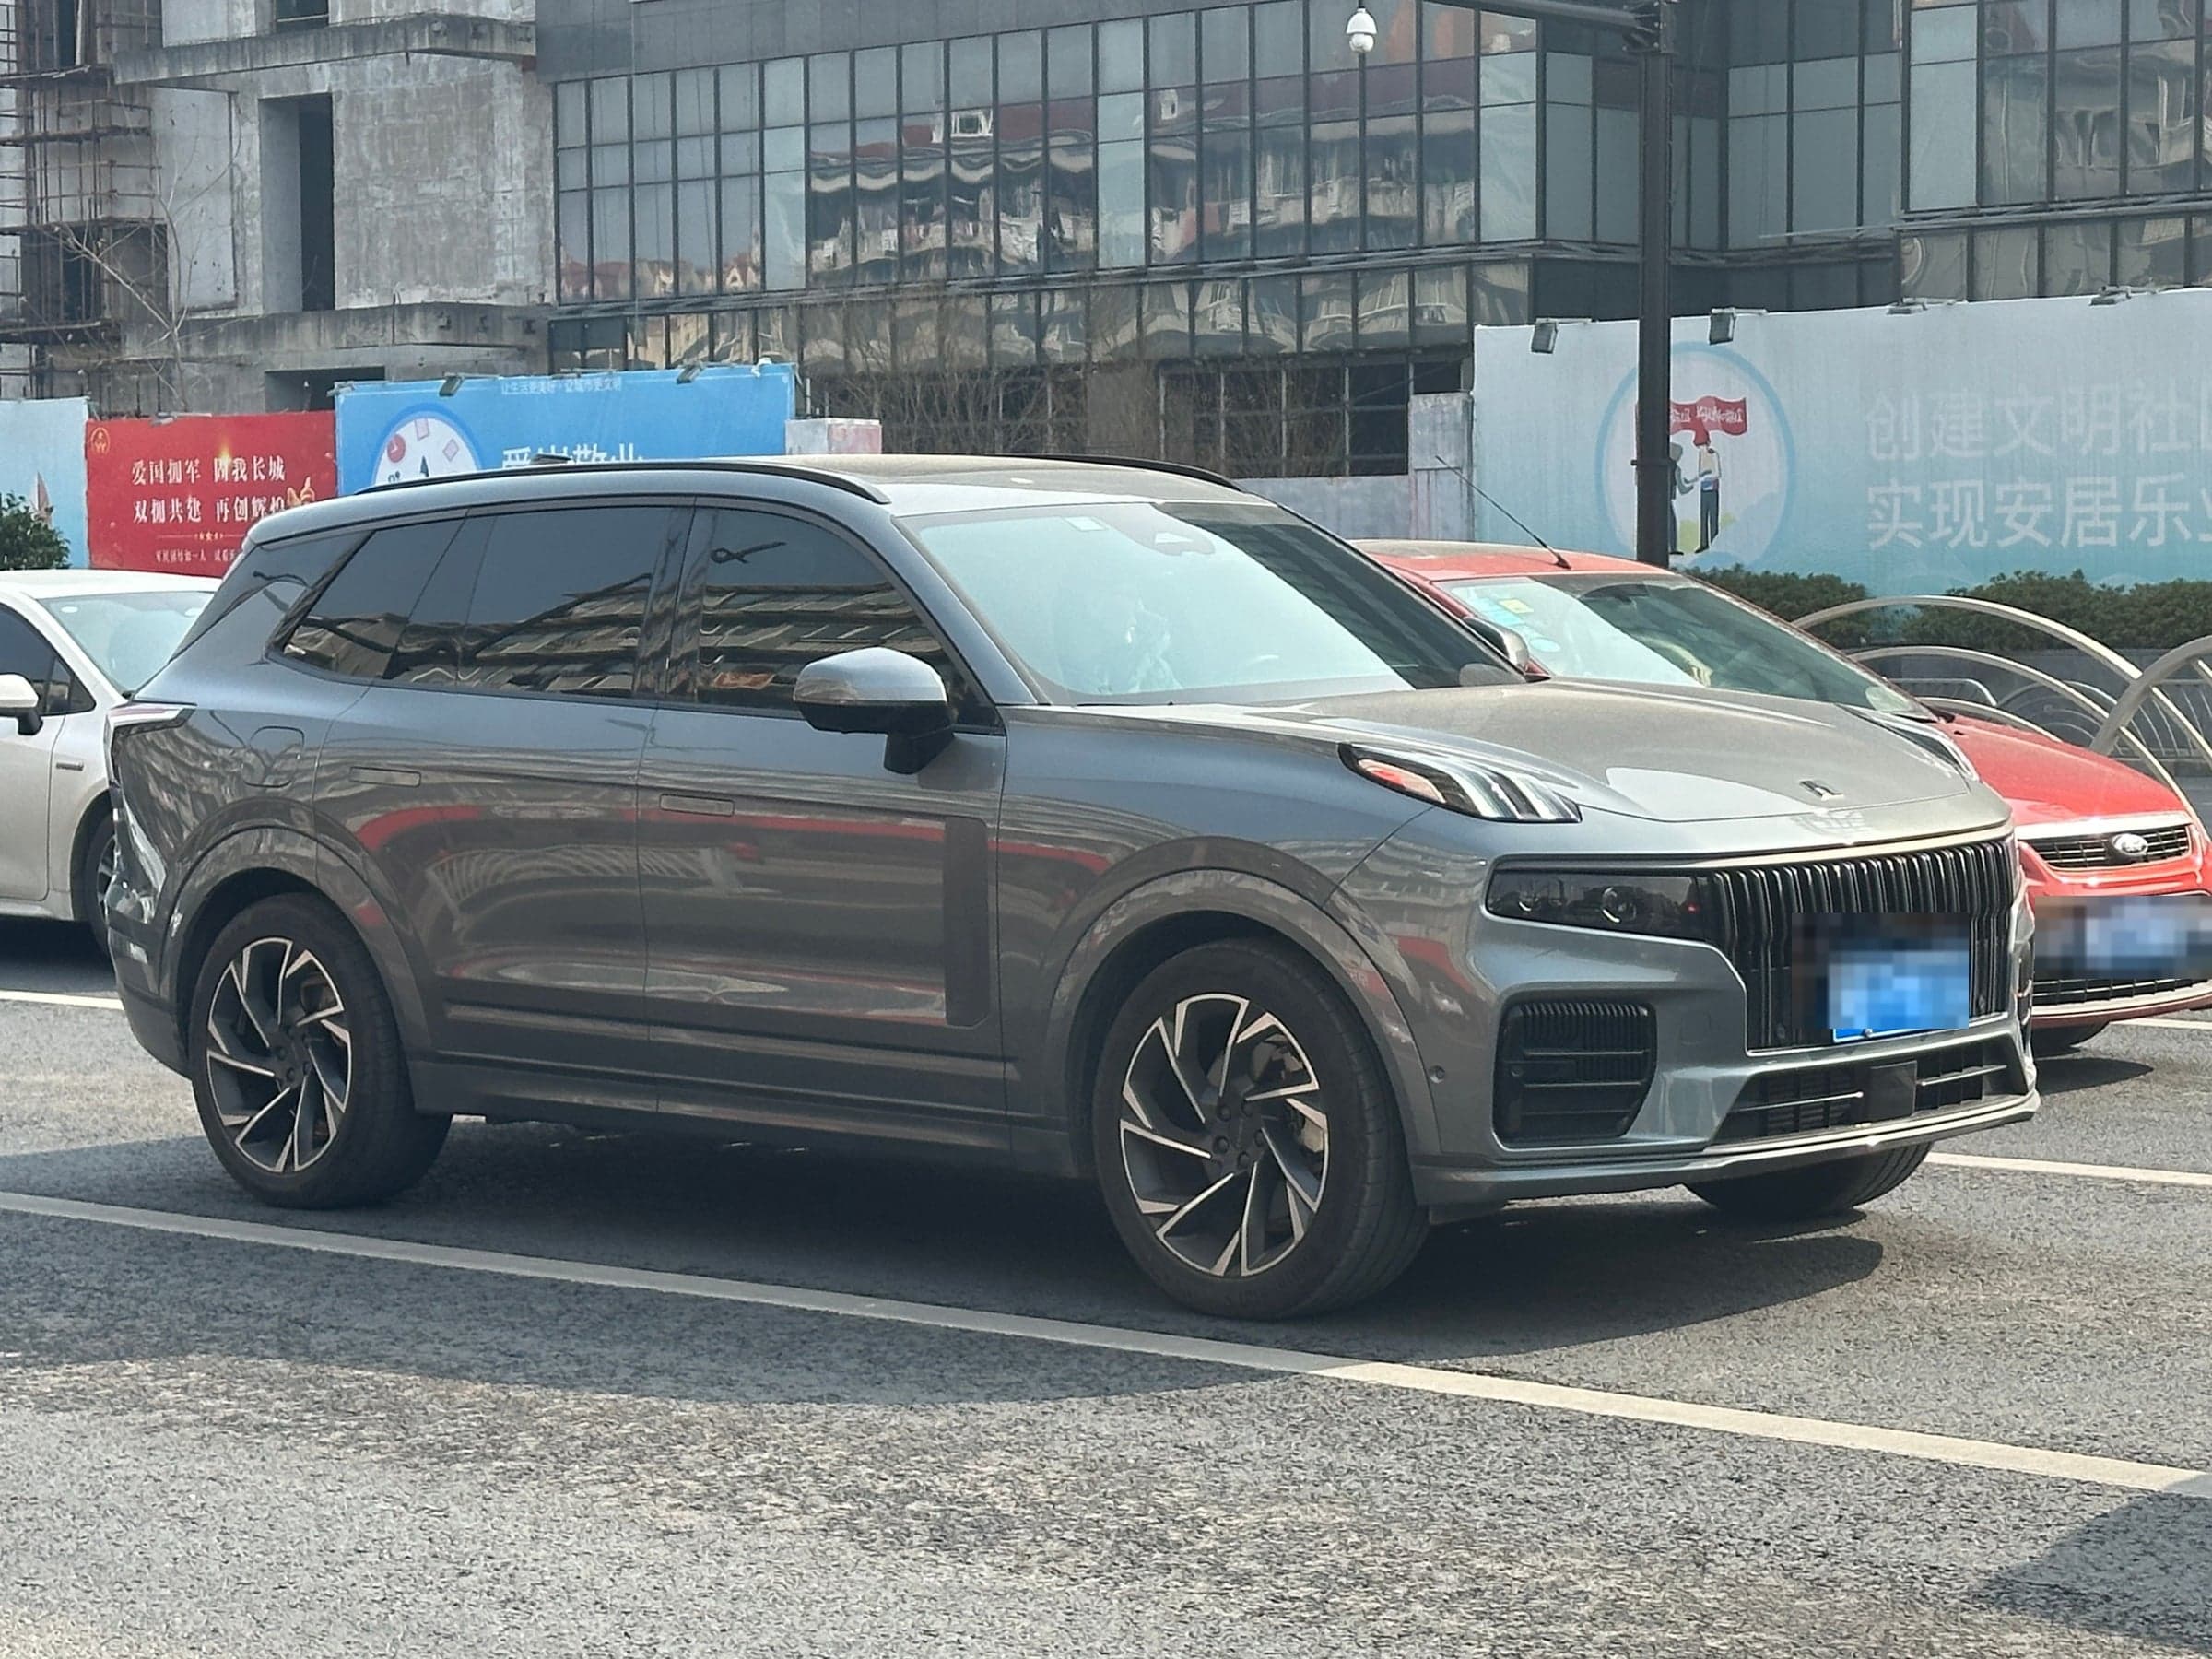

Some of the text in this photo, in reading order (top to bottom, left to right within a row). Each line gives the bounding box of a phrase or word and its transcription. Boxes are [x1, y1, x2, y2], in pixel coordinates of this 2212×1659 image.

[1865, 377, 2212, 461] 创建文明社
[132, 454, 286, 486] 爱国拥军 固我长城
[133, 494, 202, 524] 双拥共建
[1867, 472, 2212, 548] 实现安居乐
